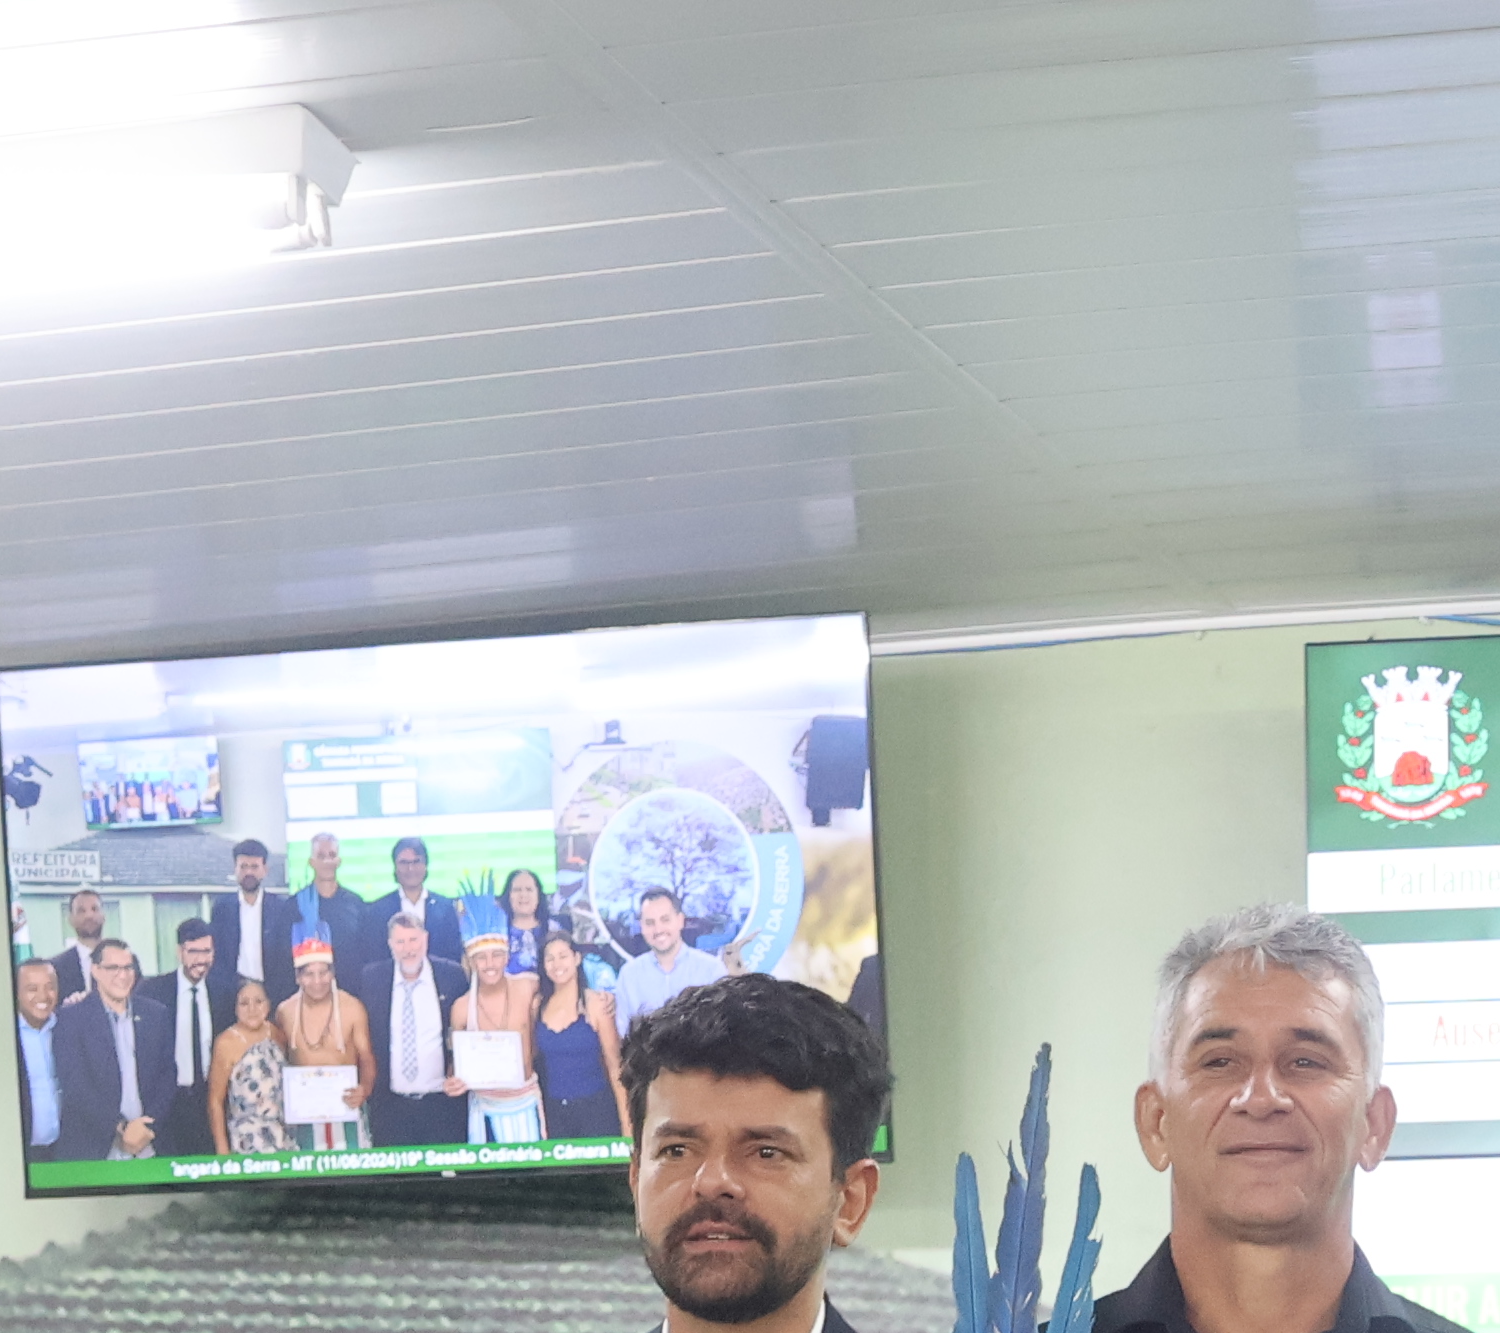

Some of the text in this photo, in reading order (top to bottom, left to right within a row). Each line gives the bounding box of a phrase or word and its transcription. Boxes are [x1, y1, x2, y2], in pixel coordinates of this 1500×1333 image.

[12, 852, 96, 865] REFEITURA
[14, 869, 93, 878] UNICIPAL
[243, 1158, 280, 1173] Serra
[291, 1155, 314, 1171] MT
